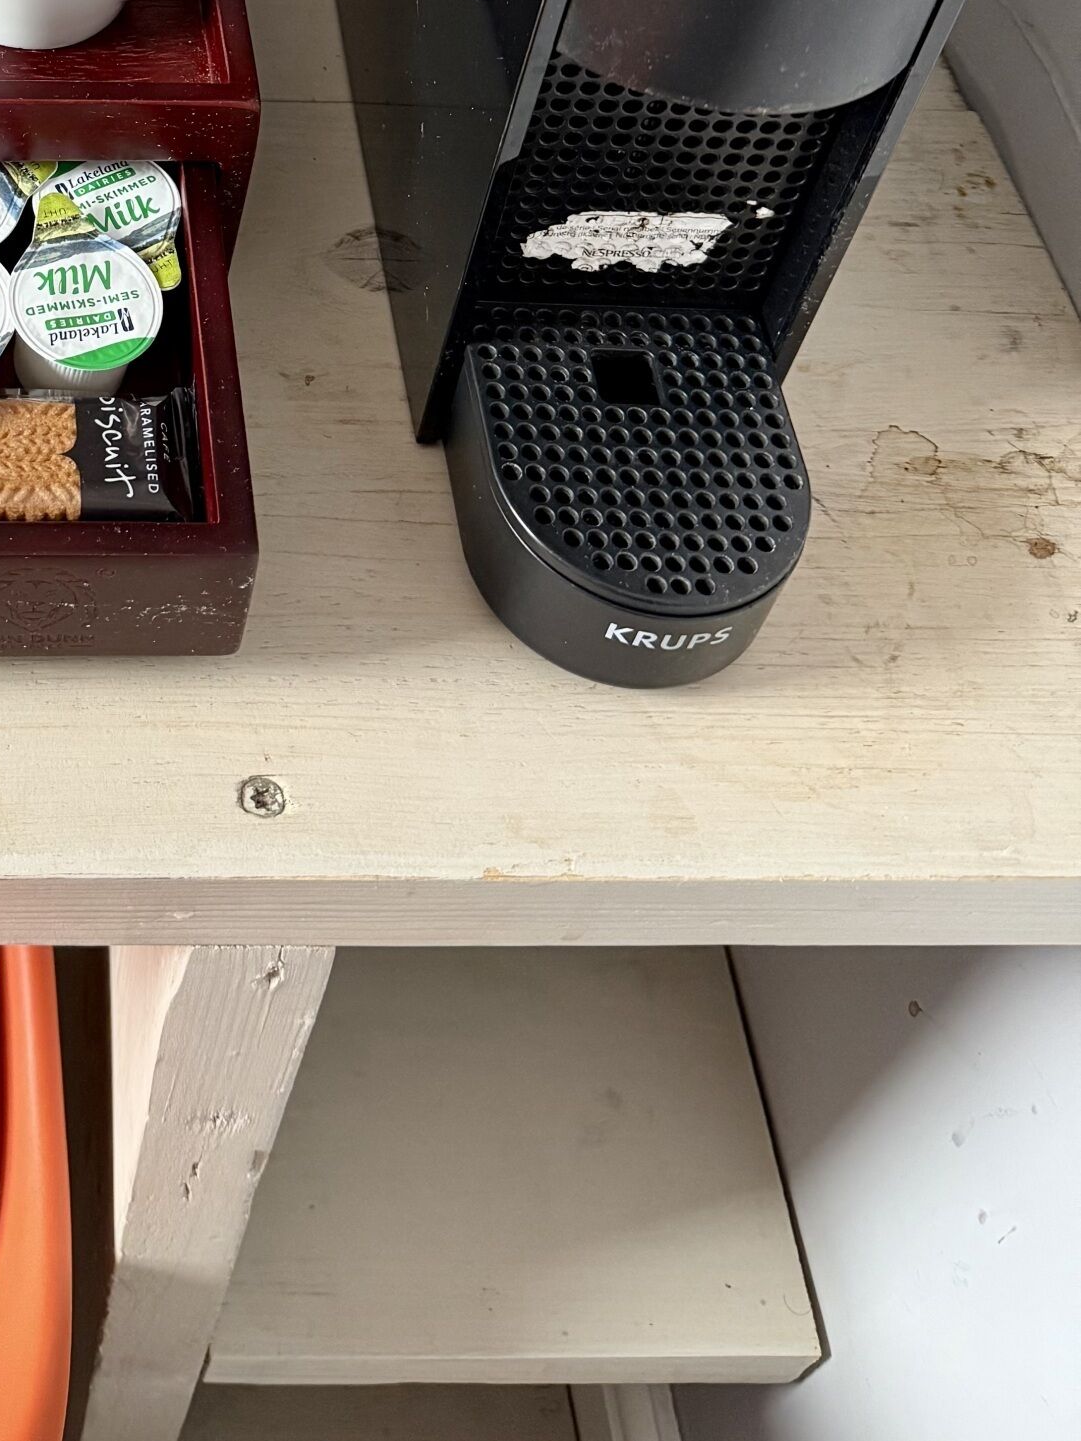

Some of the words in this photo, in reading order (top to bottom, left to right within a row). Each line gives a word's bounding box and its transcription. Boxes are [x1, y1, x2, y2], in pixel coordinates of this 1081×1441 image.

[77, 168, 133, 195] DAIRIES
[78, 175, 157, 210] MI-SKIMMED
[42, 207, 68, 219] UHT
[86, 194, 161, 233] Milk
[581, 248, 651, 258] NESPRESSO
[33, 260, 112, 296] Milk
[25, 289, 140, 317] SEMI-SKIMMED
[48, 322, 119, 346] Lakeland
[49, 313, 113, 328] DAIRIES
[140, 401, 160, 494] ARAMELISED
[604, 622, 733, 650] KRUPS
